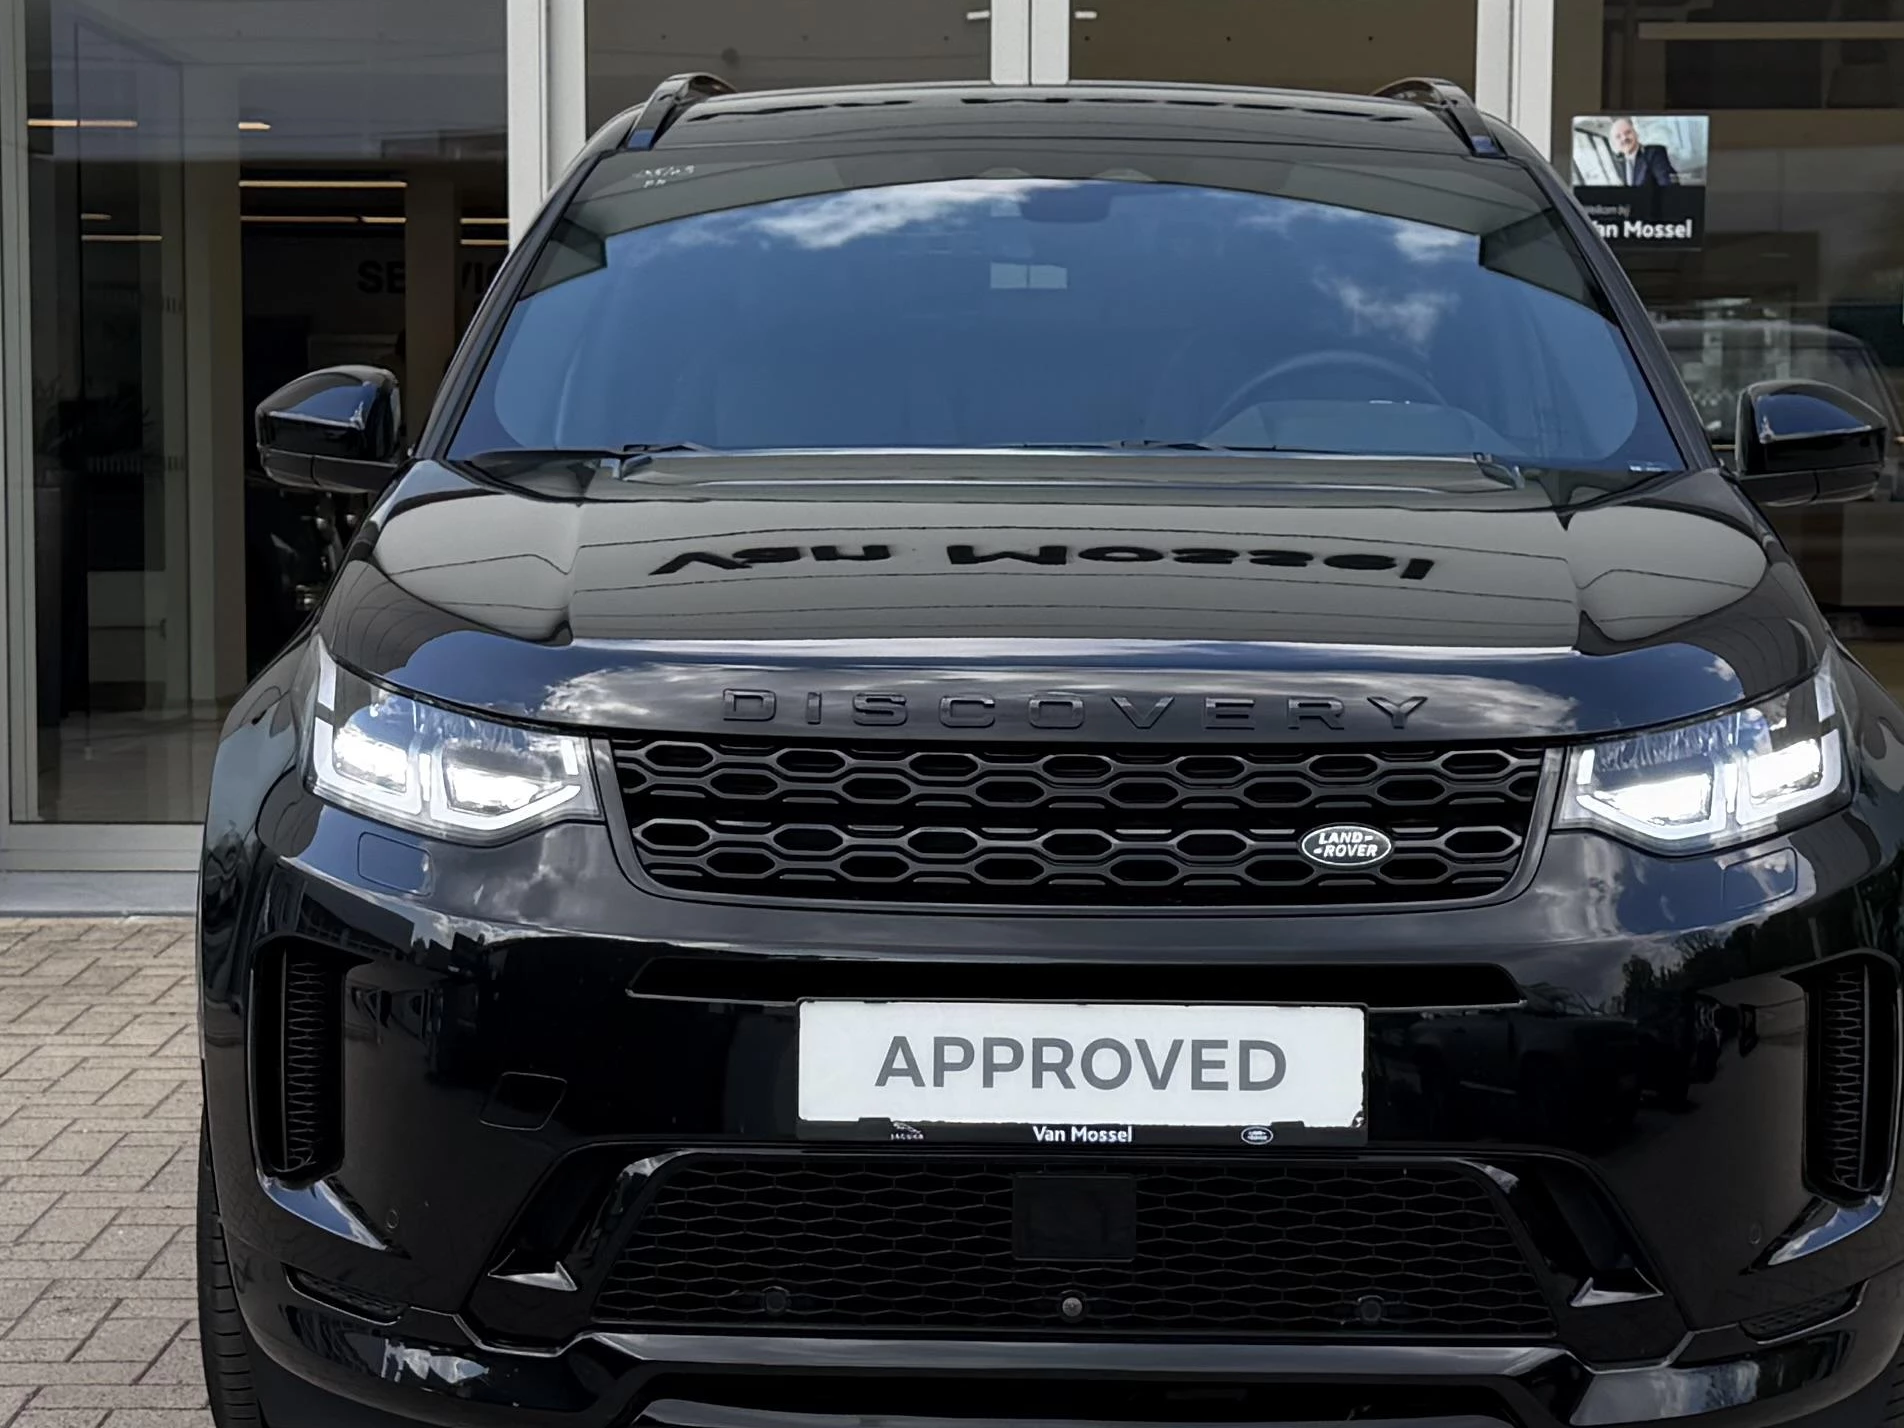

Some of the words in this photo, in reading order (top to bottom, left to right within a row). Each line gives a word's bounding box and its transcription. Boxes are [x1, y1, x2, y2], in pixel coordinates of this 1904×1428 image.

[1593, 220, 1619, 238] an
[1623, 218, 1693, 239] Mossel
[721, 687, 1429, 732] DISCOVERY
[874, 1035, 1287, 1092] APPROVED
[1032, 1125, 1066, 1142] Van
[1070, 1125, 1133, 1143] Mossel
